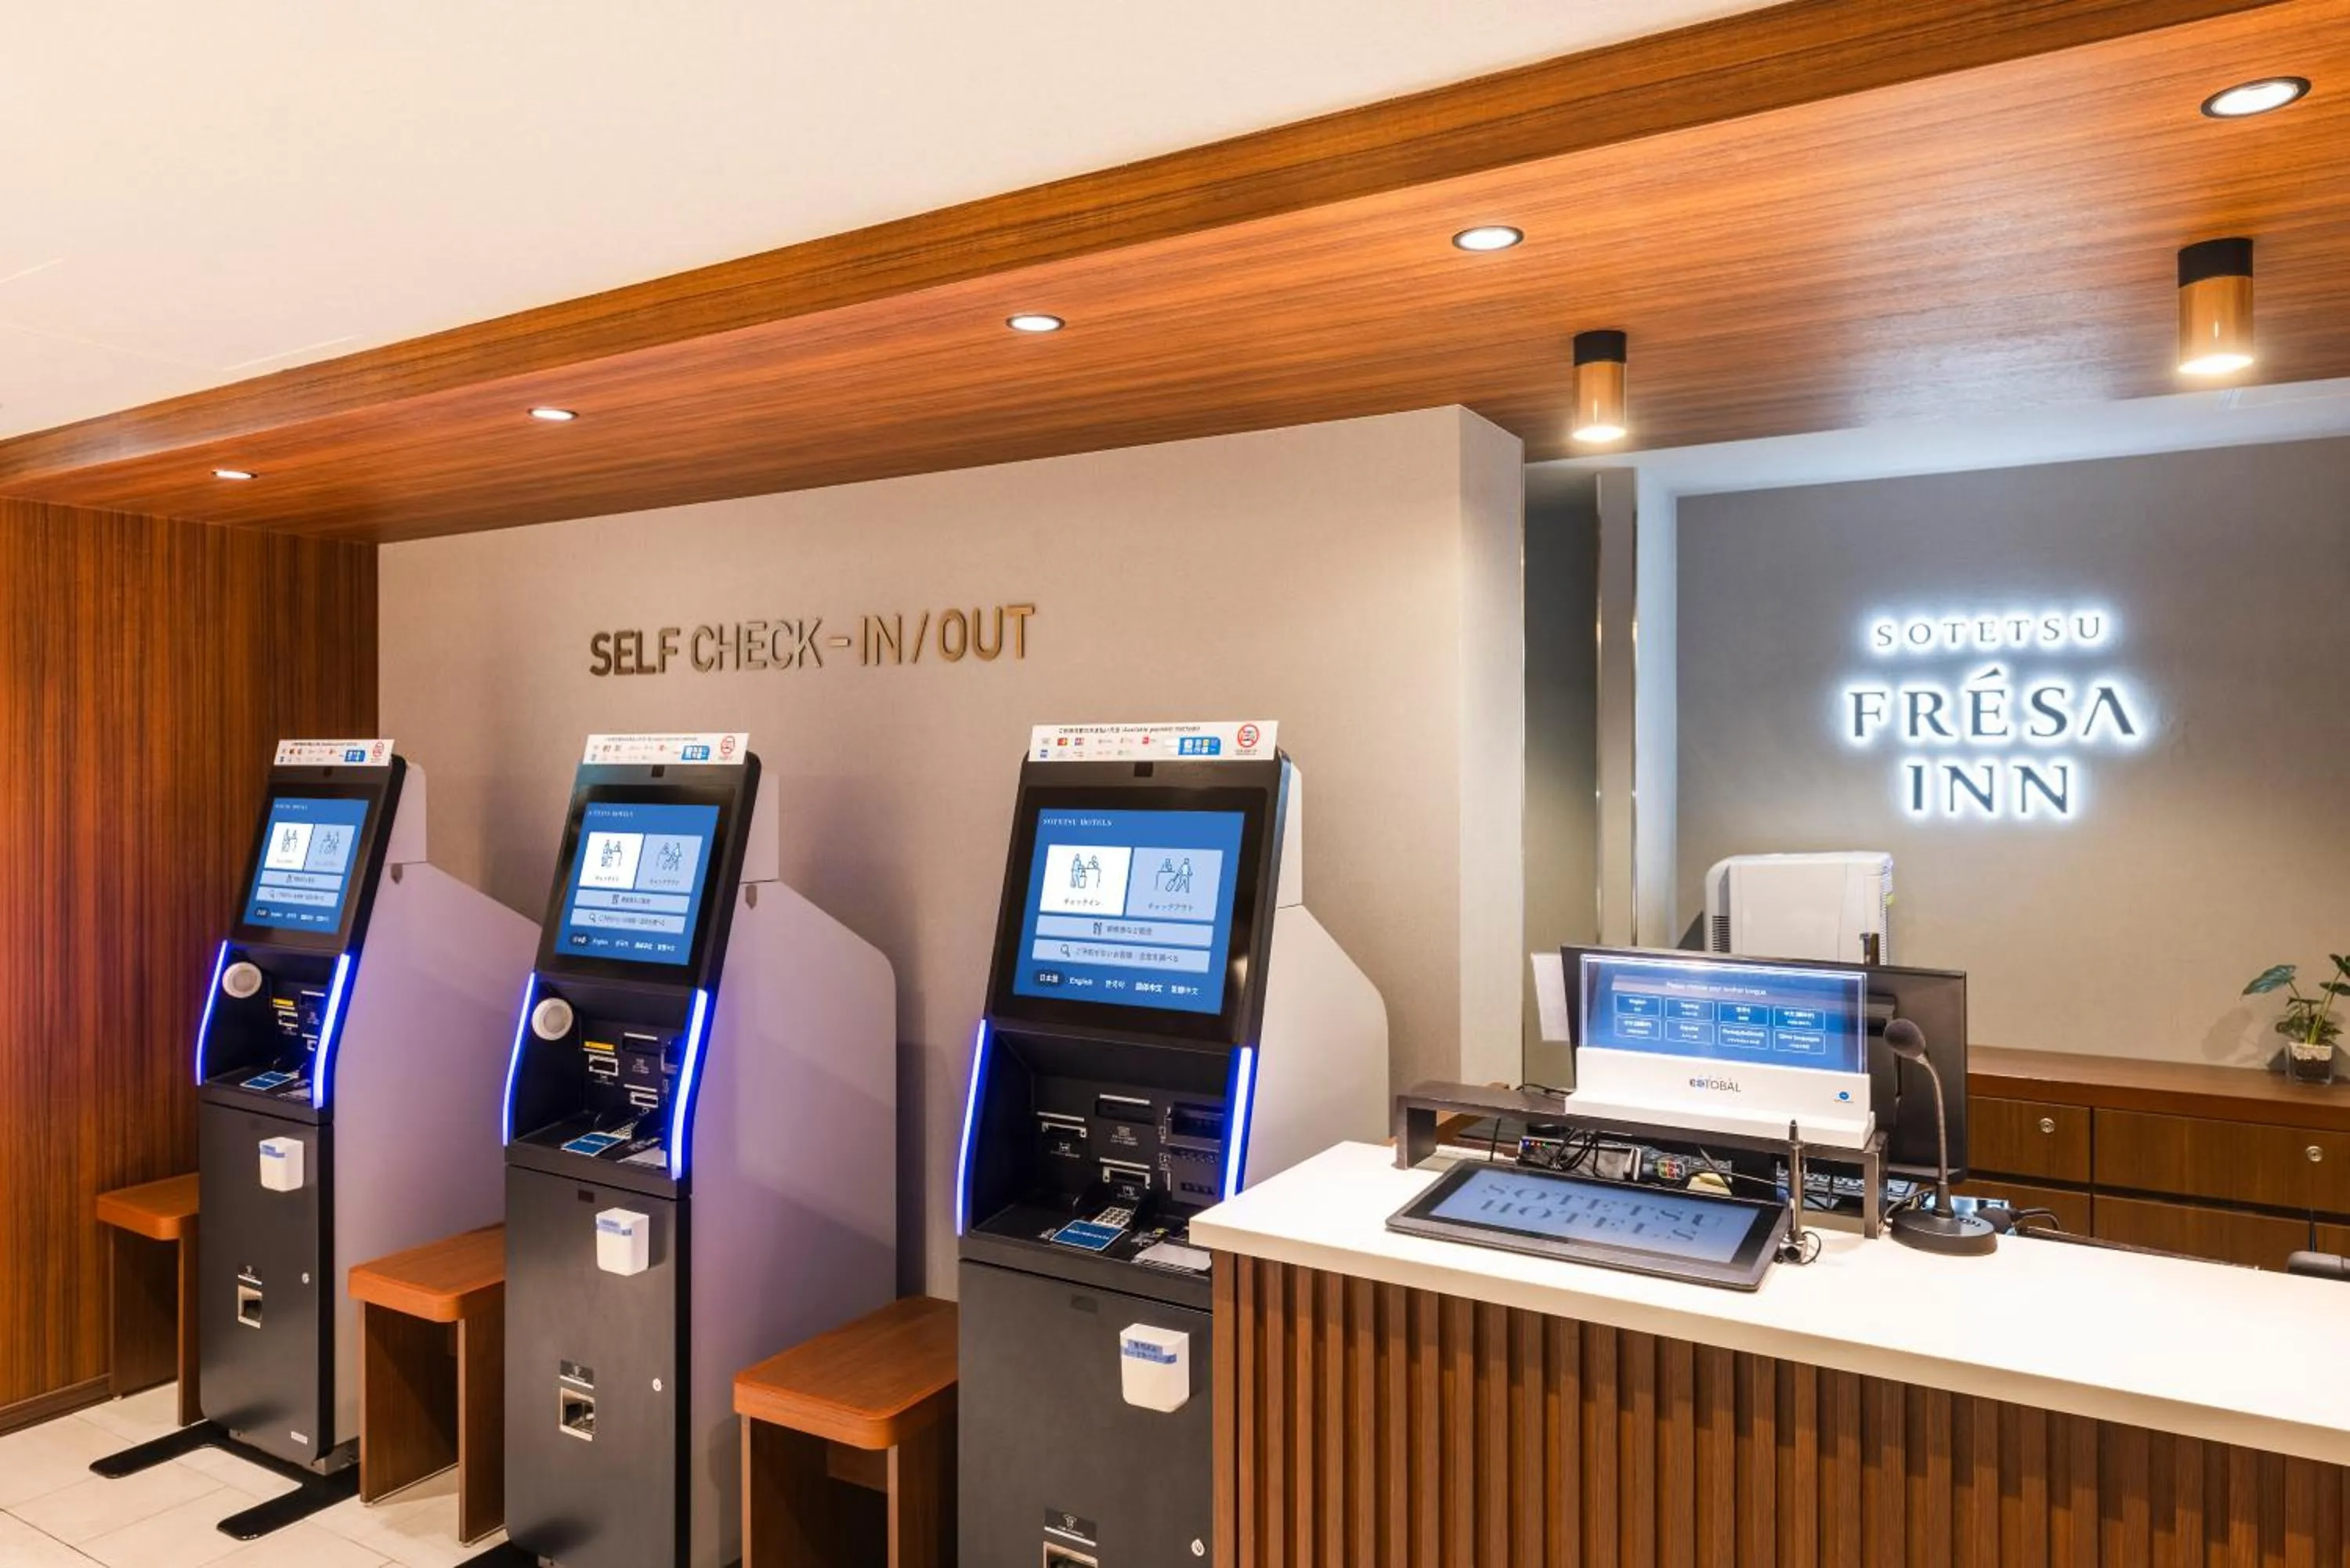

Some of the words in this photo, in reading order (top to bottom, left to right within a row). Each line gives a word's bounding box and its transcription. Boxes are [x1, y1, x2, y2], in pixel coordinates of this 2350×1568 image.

[589, 627, 680, 677] SELF
[1877, 616, 2100, 646] SOTETSU
[1849, 667, 2136, 737] FRÉSA
[1907, 764, 2069, 814] INN
[1480, 1183, 1723, 1228] SOTETSU
[1480, 1199, 1699, 1242] HOTELS
